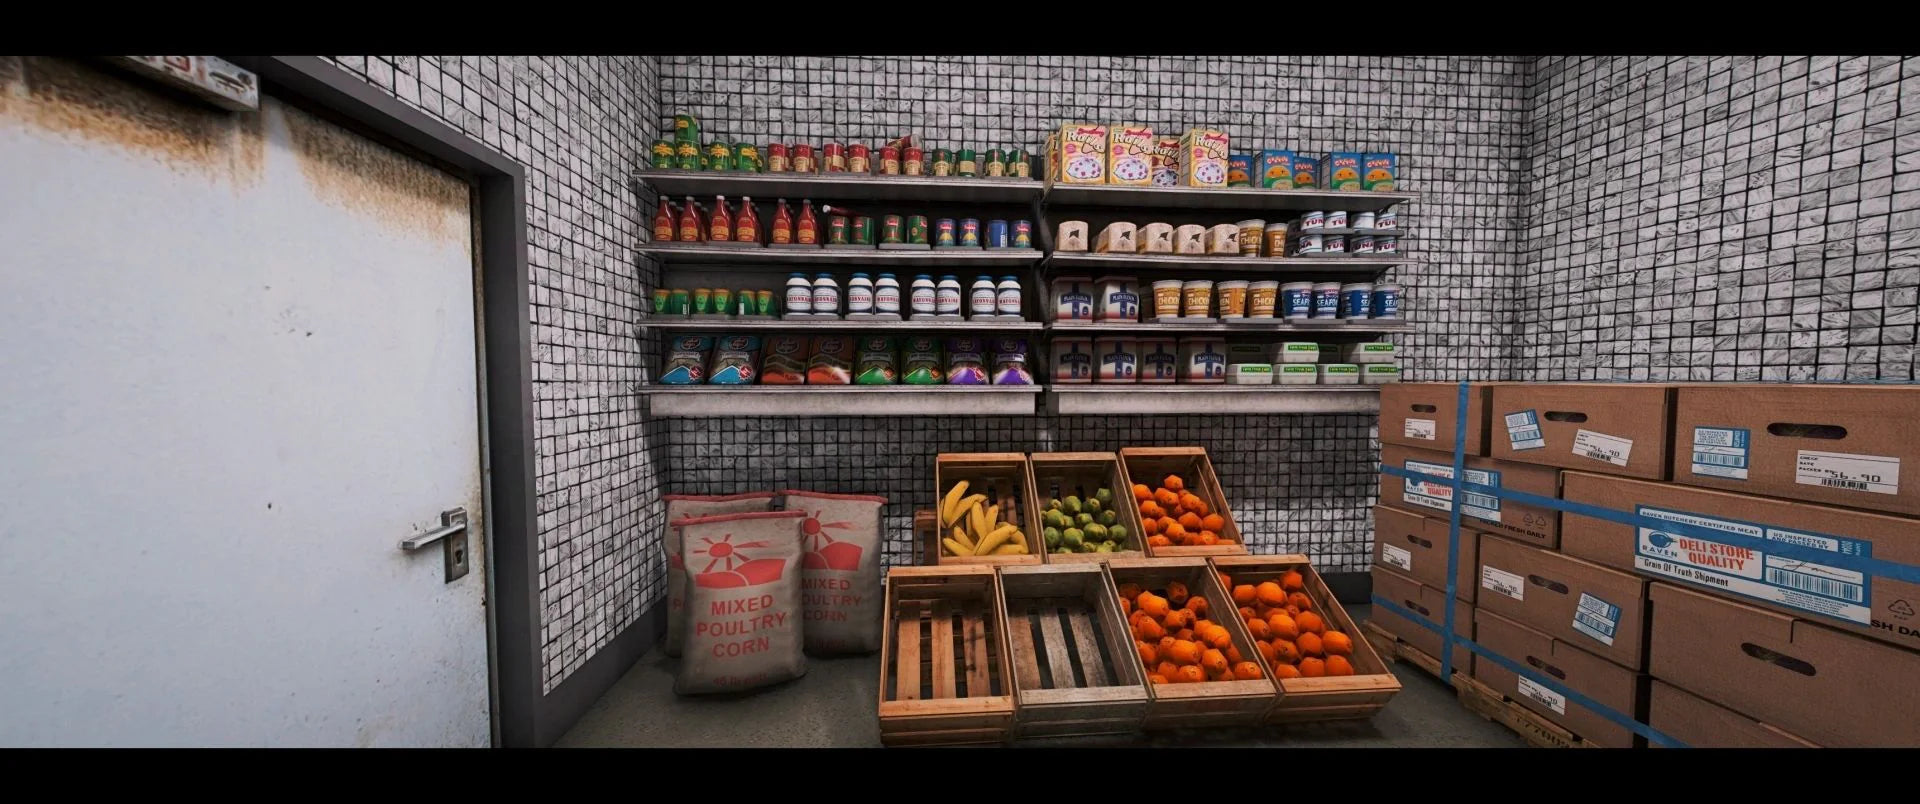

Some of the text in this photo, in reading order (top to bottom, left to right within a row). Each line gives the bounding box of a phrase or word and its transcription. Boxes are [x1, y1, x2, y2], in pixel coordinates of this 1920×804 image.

[1642, 544, 1678, 557] RAVEN
[1679, 538, 1707, 553] DELI
[1709, 541, 1754, 560] STORE
[1688, 551, 1745, 570] QUALITY
[801, 577, 851, 590] MIXED
[1694, 570, 1729, 587] Shipment
[711, 594, 774, 616] MIXED
[801, 593, 862, 606] OULTRY
[696, 611, 787, 637] POULTRY
[713, 636, 769, 658] CORN
